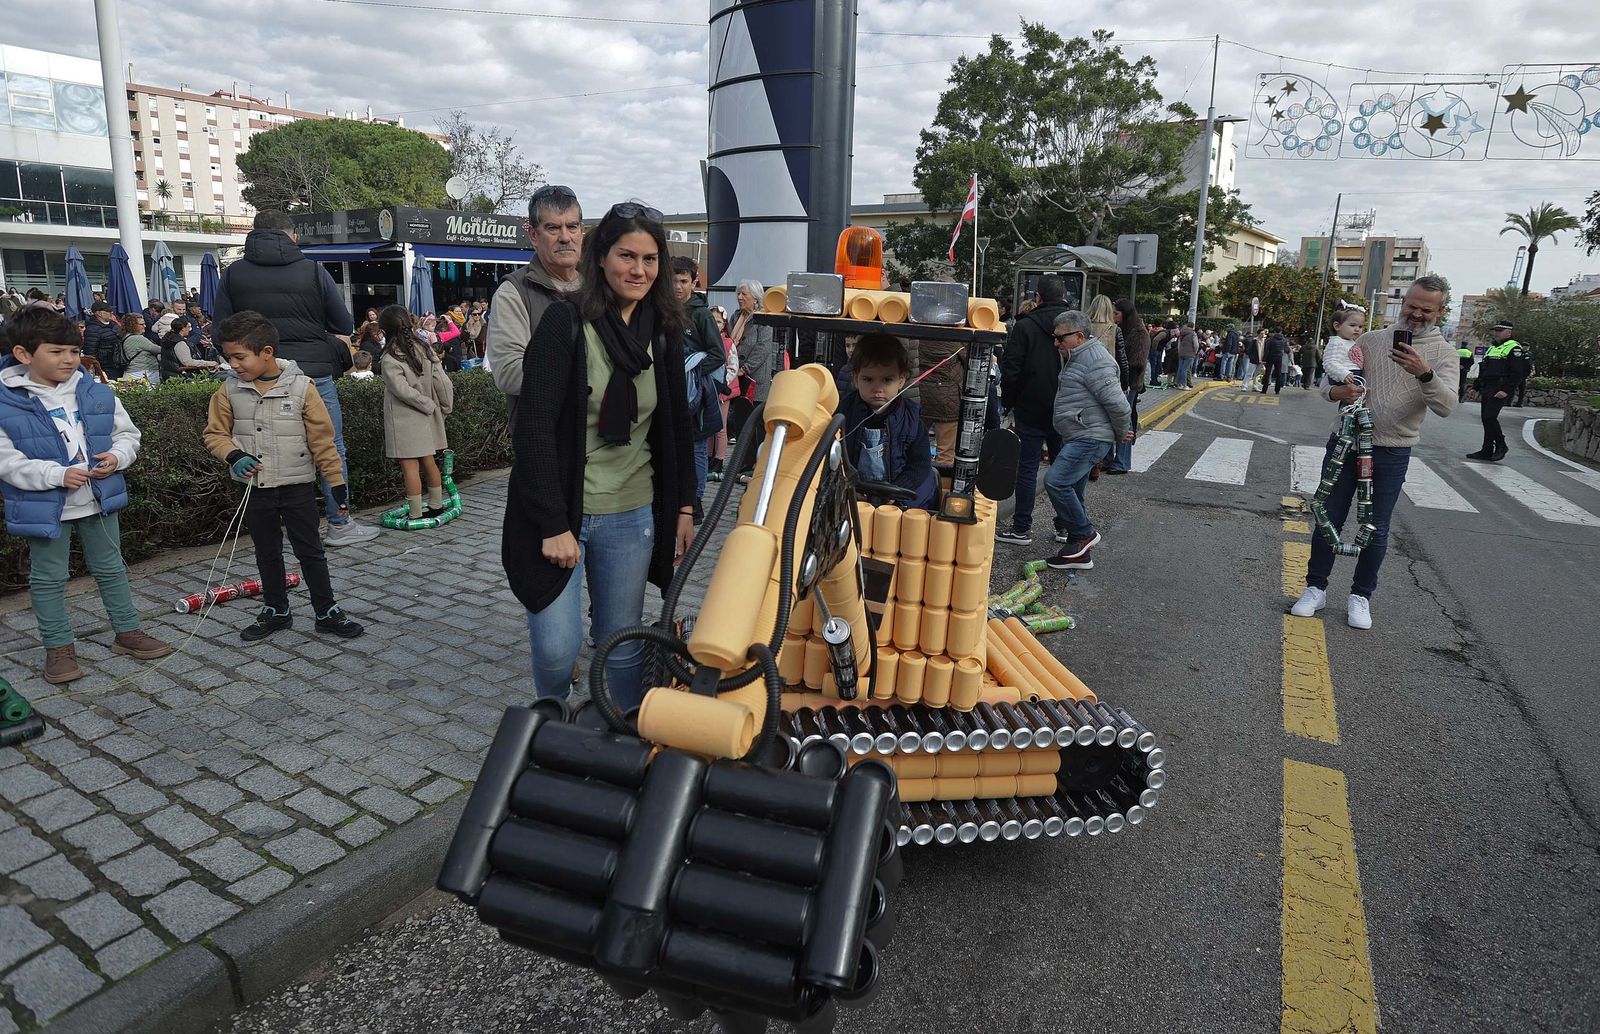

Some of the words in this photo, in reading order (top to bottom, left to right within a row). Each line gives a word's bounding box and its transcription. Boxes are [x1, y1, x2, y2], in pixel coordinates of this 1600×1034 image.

[304, 222, 314, 236] Bar
[446, 215, 517, 238] Montana
[1211, 392, 1280, 406] BUS
